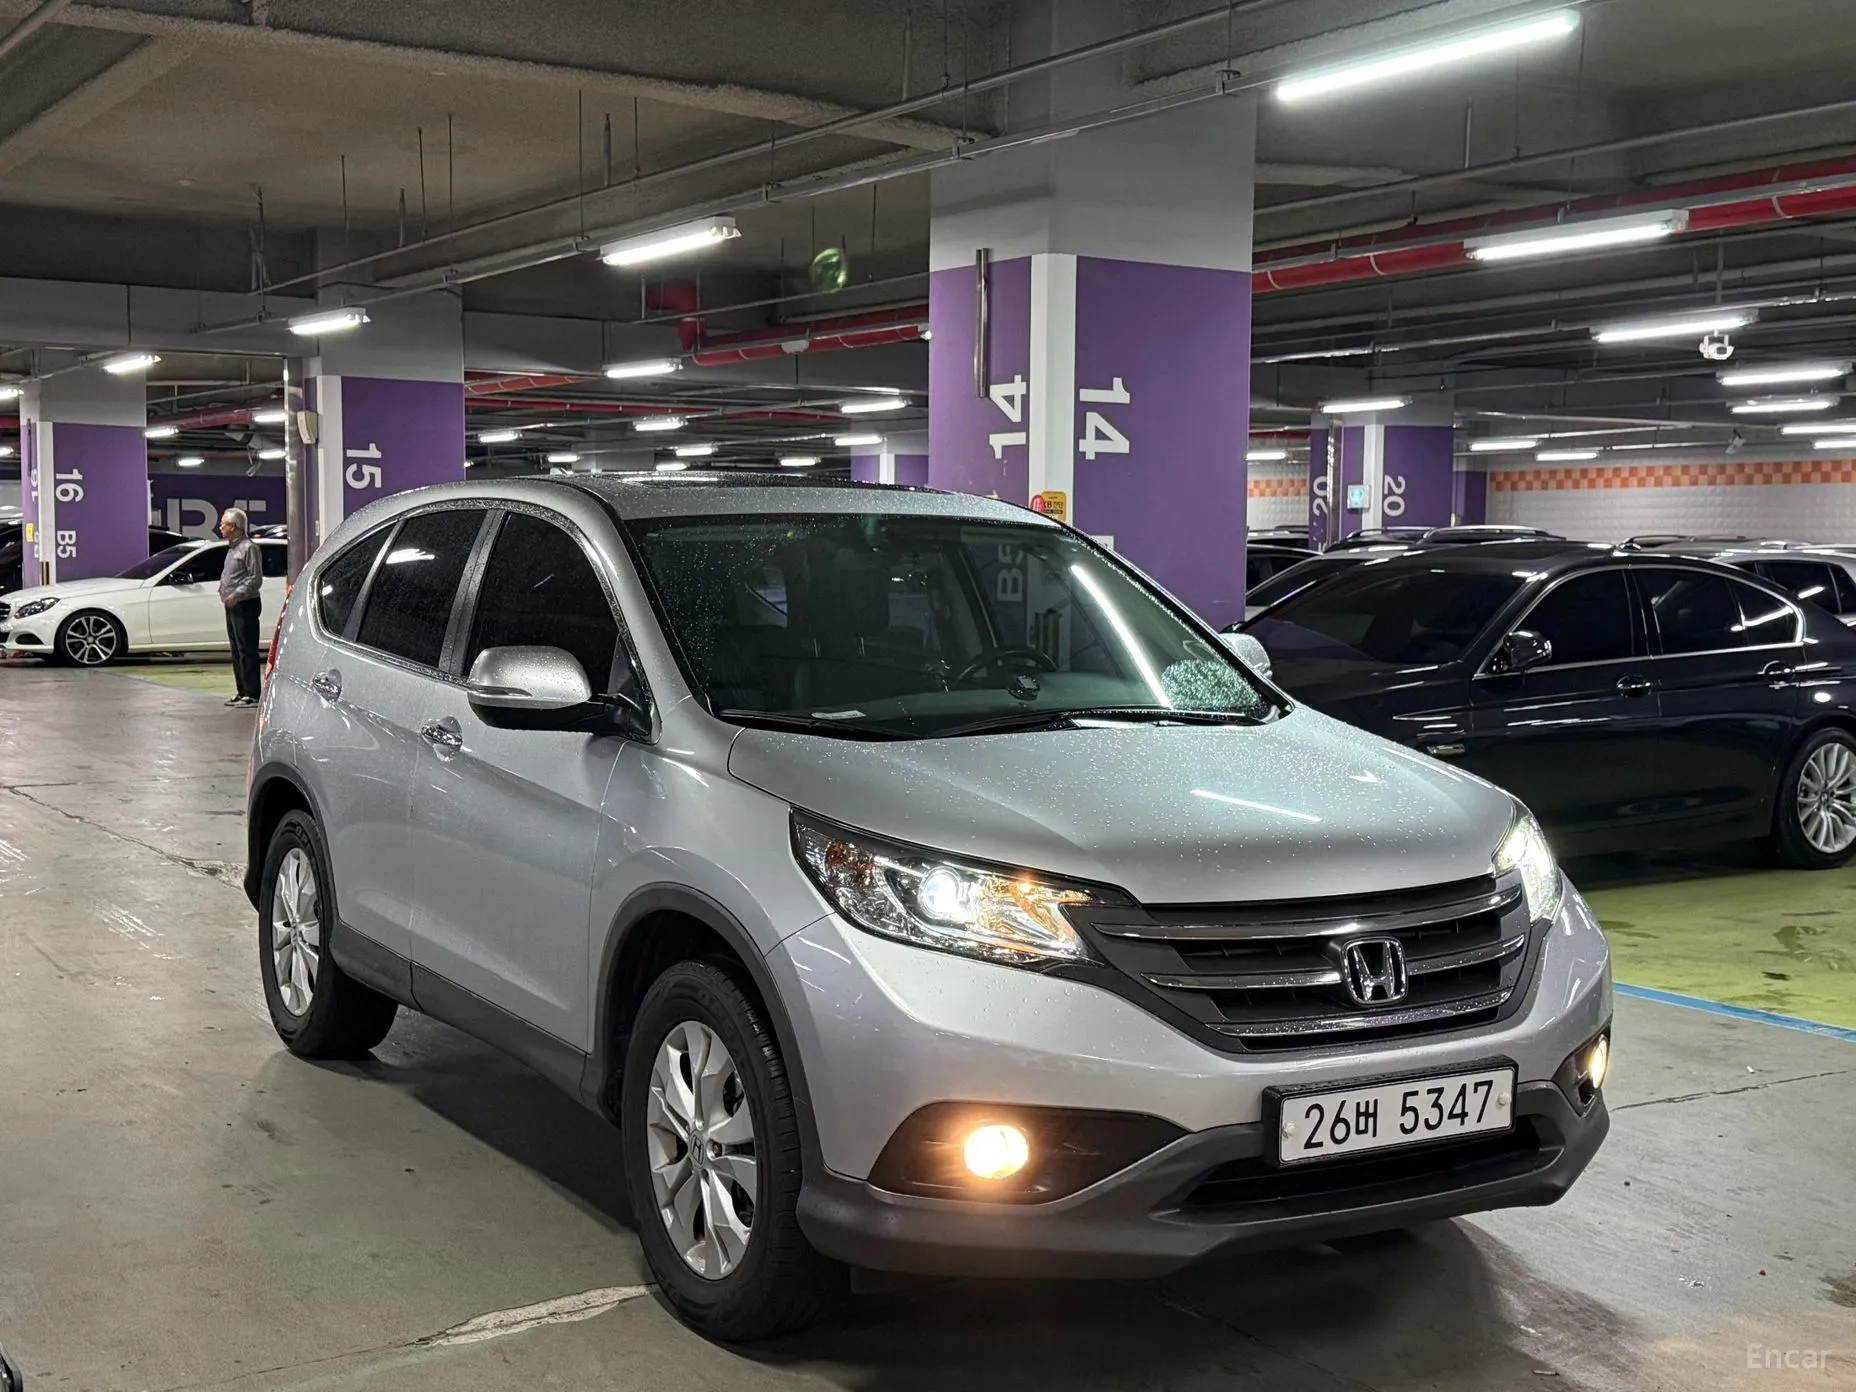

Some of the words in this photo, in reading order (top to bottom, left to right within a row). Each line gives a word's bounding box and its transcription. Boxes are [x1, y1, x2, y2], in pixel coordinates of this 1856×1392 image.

[989, 375, 1026, 459] 14
[1079, 377, 1130, 460] 14
[56, 469, 83, 502] 16
[346, 443, 381, 489] 15
[1383, 475, 1405, 516] 20
[57, 530, 76, 558] B5
[1304, 1098, 1378, 1149] 26버
[1400, 1080, 1493, 1134] 5347
